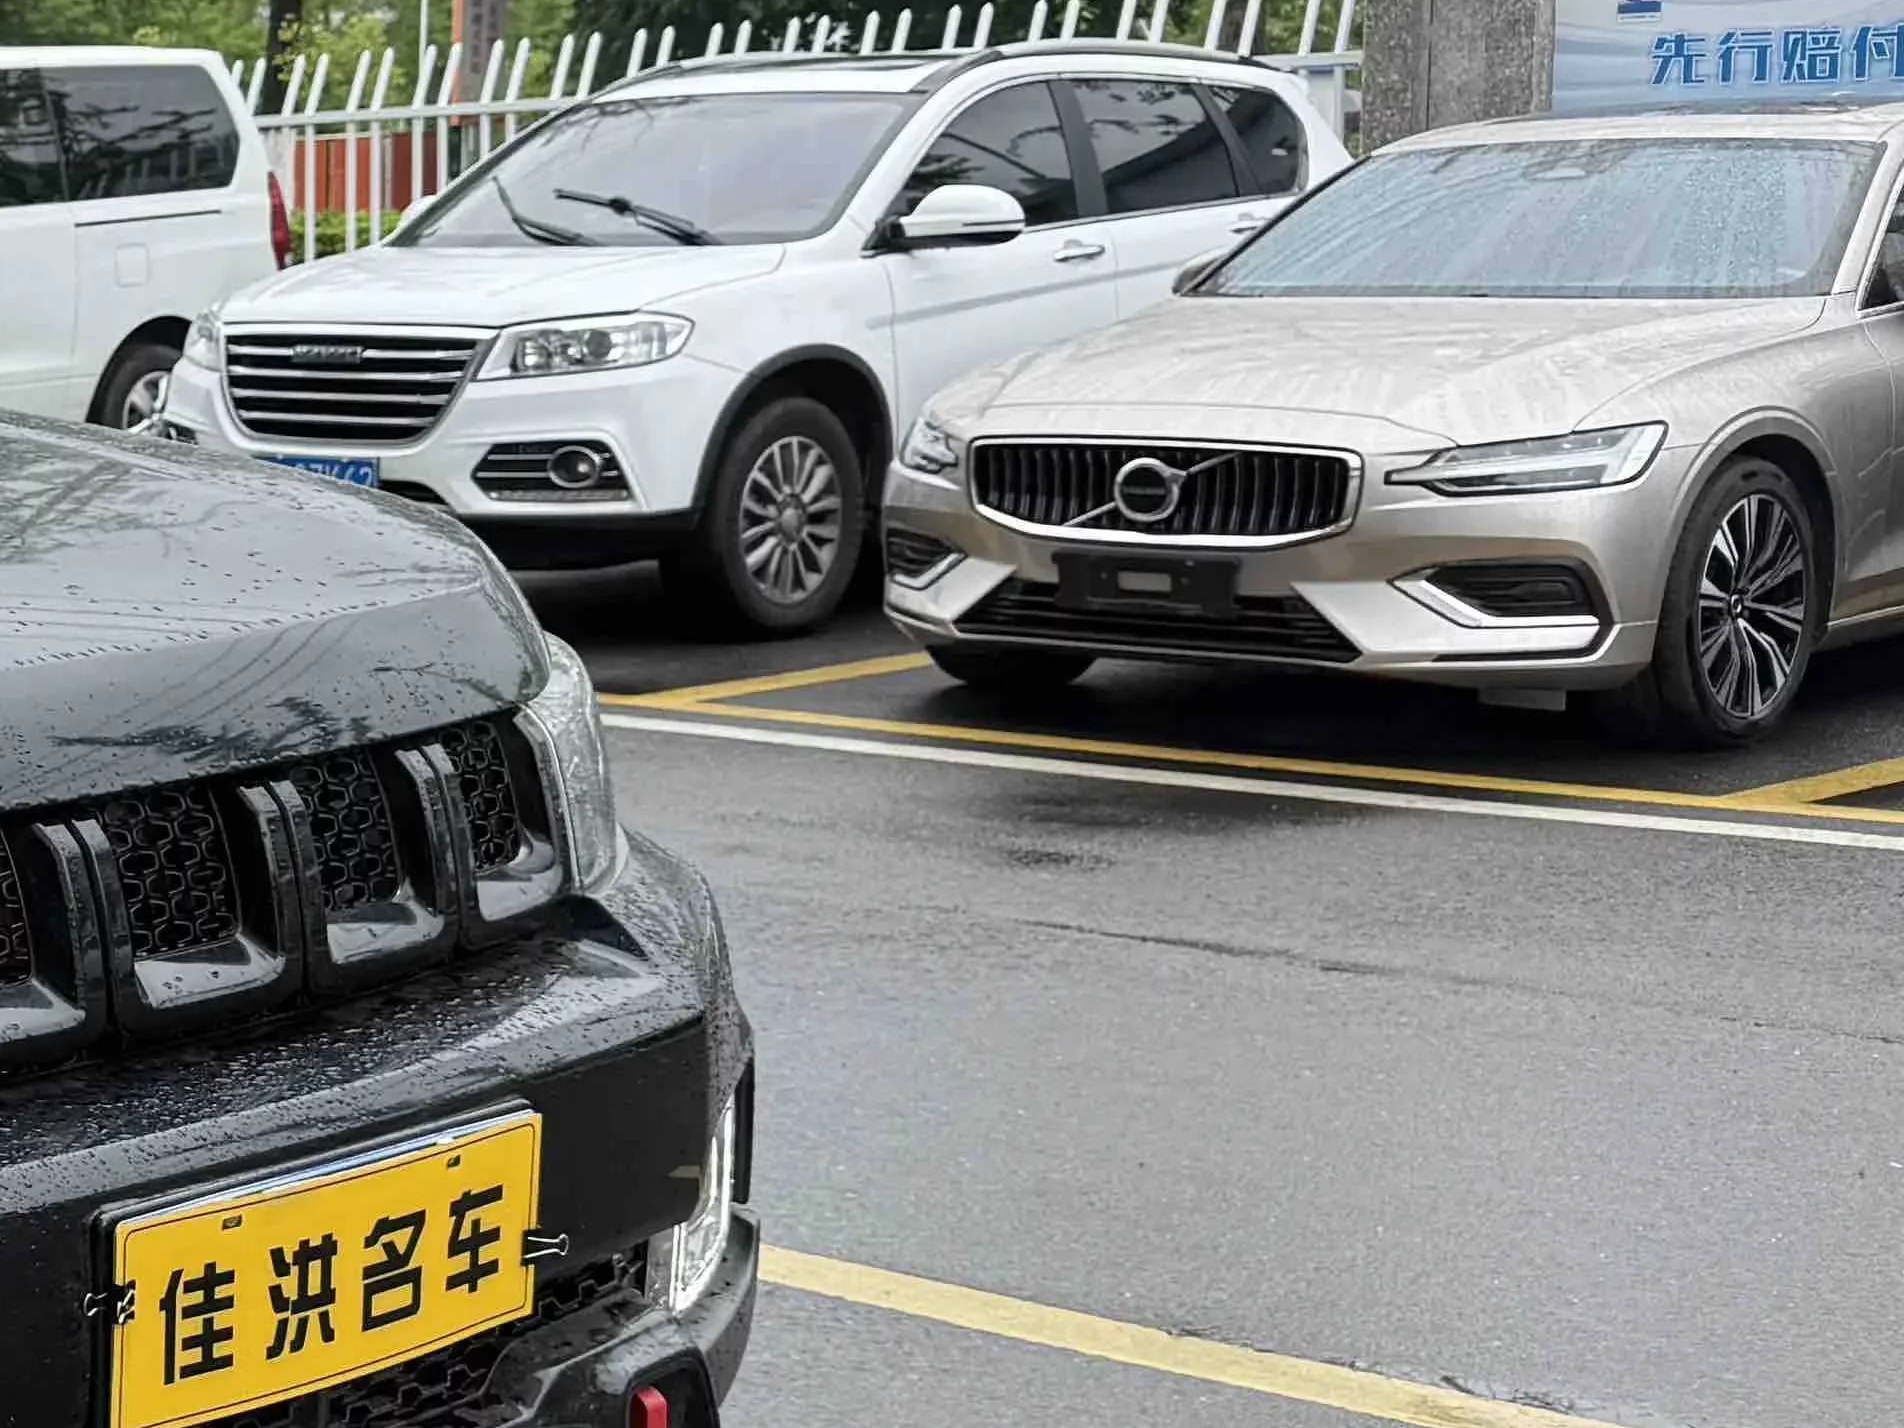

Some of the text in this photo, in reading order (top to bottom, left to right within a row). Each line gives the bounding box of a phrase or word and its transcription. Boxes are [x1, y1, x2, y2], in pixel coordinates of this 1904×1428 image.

[1650, 23, 1904, 85] 先行赔付
[158, 1184, 504, 1386] 佳洪名车
